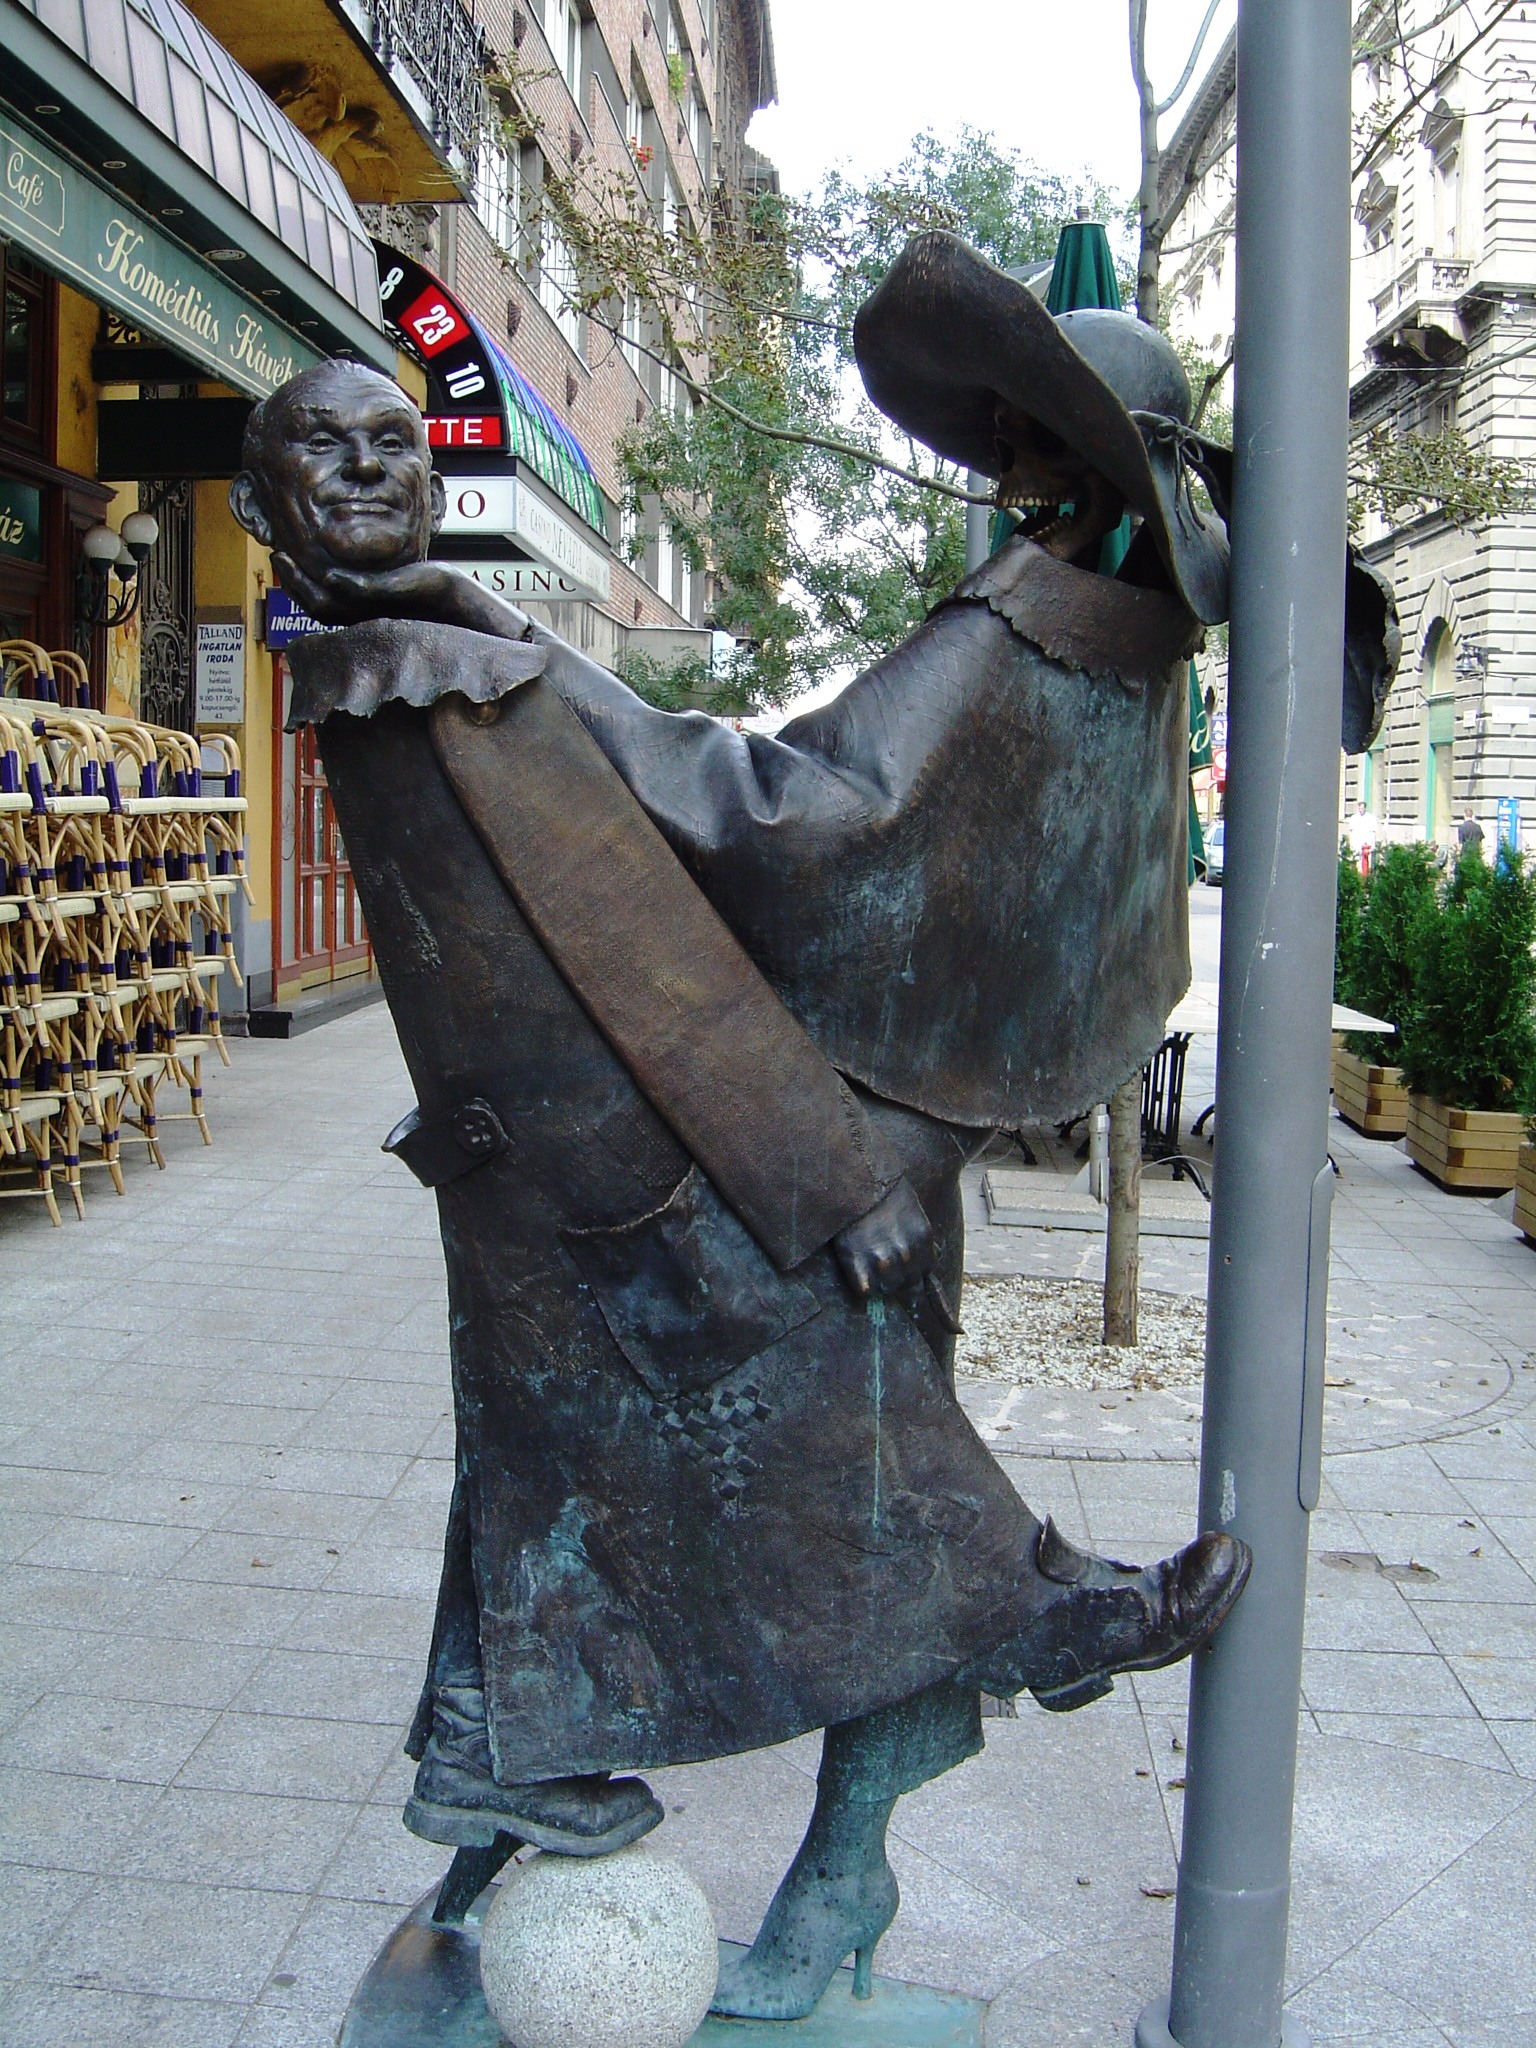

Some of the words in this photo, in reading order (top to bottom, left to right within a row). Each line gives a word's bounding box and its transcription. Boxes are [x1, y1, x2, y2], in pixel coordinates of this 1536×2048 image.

[7, 152, 45, 209] Café
[380, 267, 404, 300] 8
[97, 219, 221, 346] Komédiás
[230, 313, 302, 387] Kávéh
[412, 304, 456, 346] 23
[445, 362, 486, 399] 10
[198, 642, 243, 651] INGATLAN
[199, 626, 243, 640] TALLAND
[205, 654, 234, 663] IRODA
